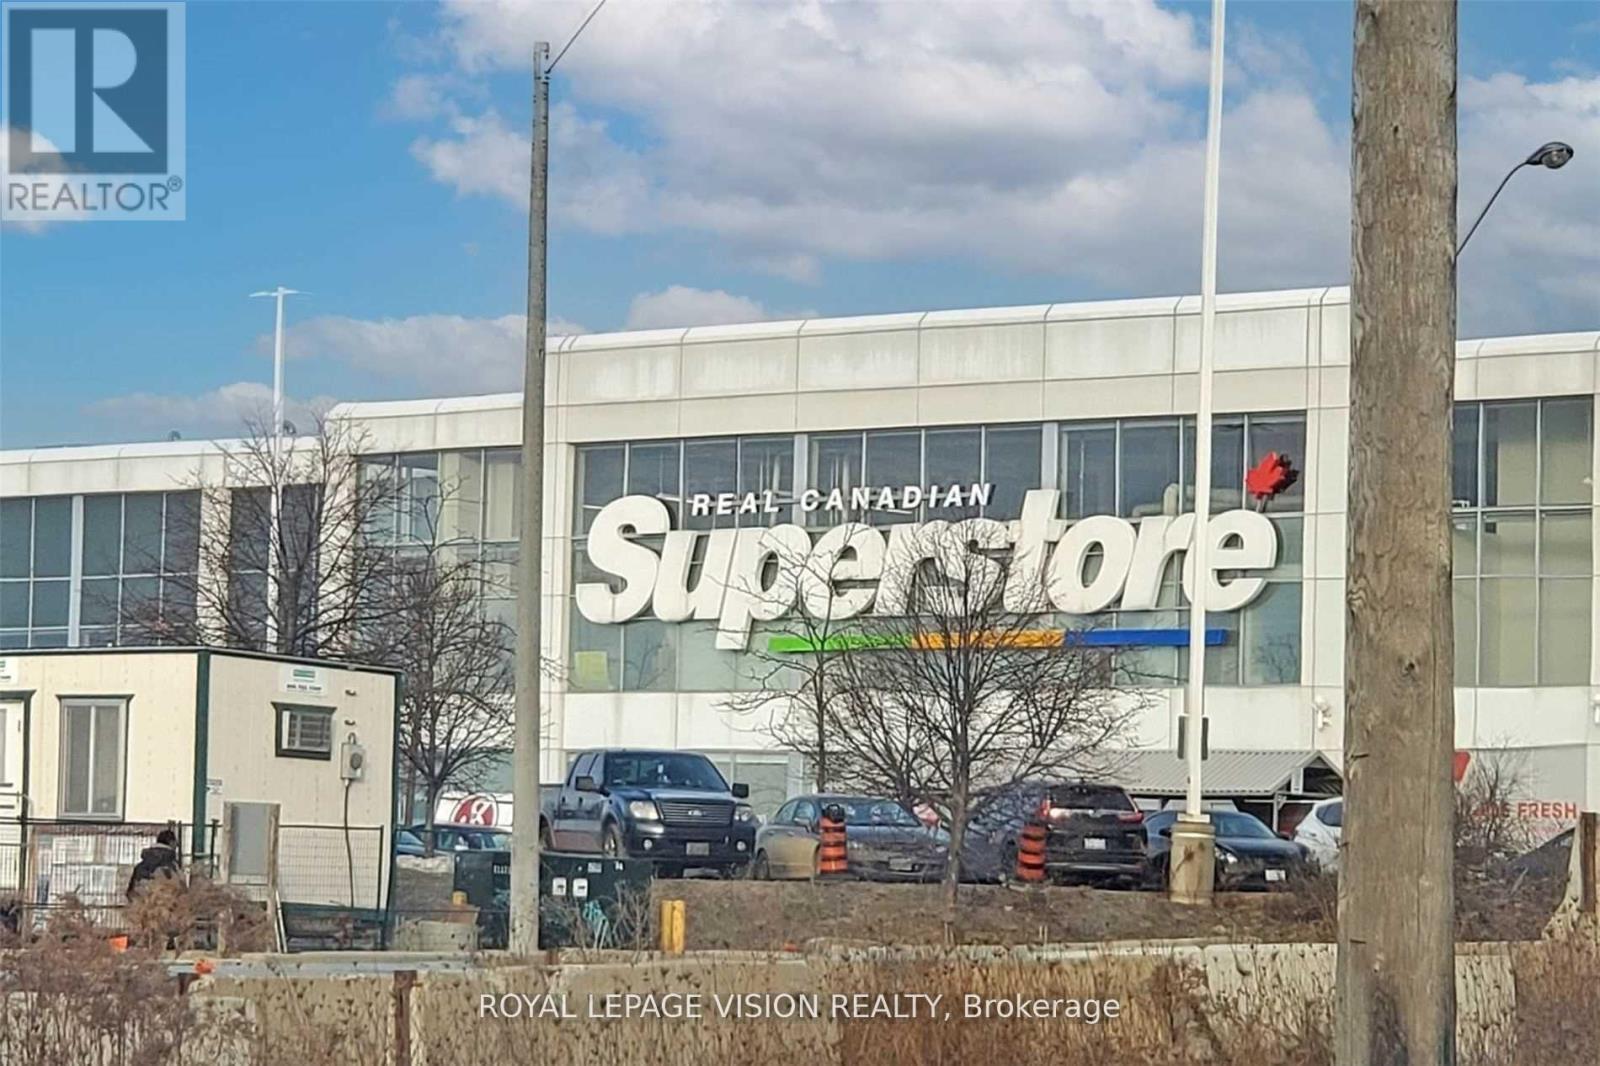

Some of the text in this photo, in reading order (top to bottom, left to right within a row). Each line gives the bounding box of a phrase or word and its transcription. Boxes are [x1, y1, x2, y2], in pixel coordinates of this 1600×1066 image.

[691, 482, 992, 517] REAL CANADIAN
[576, 488, 1279, 650] Superstore
[1517, 802, 1577, 819] FRESH
